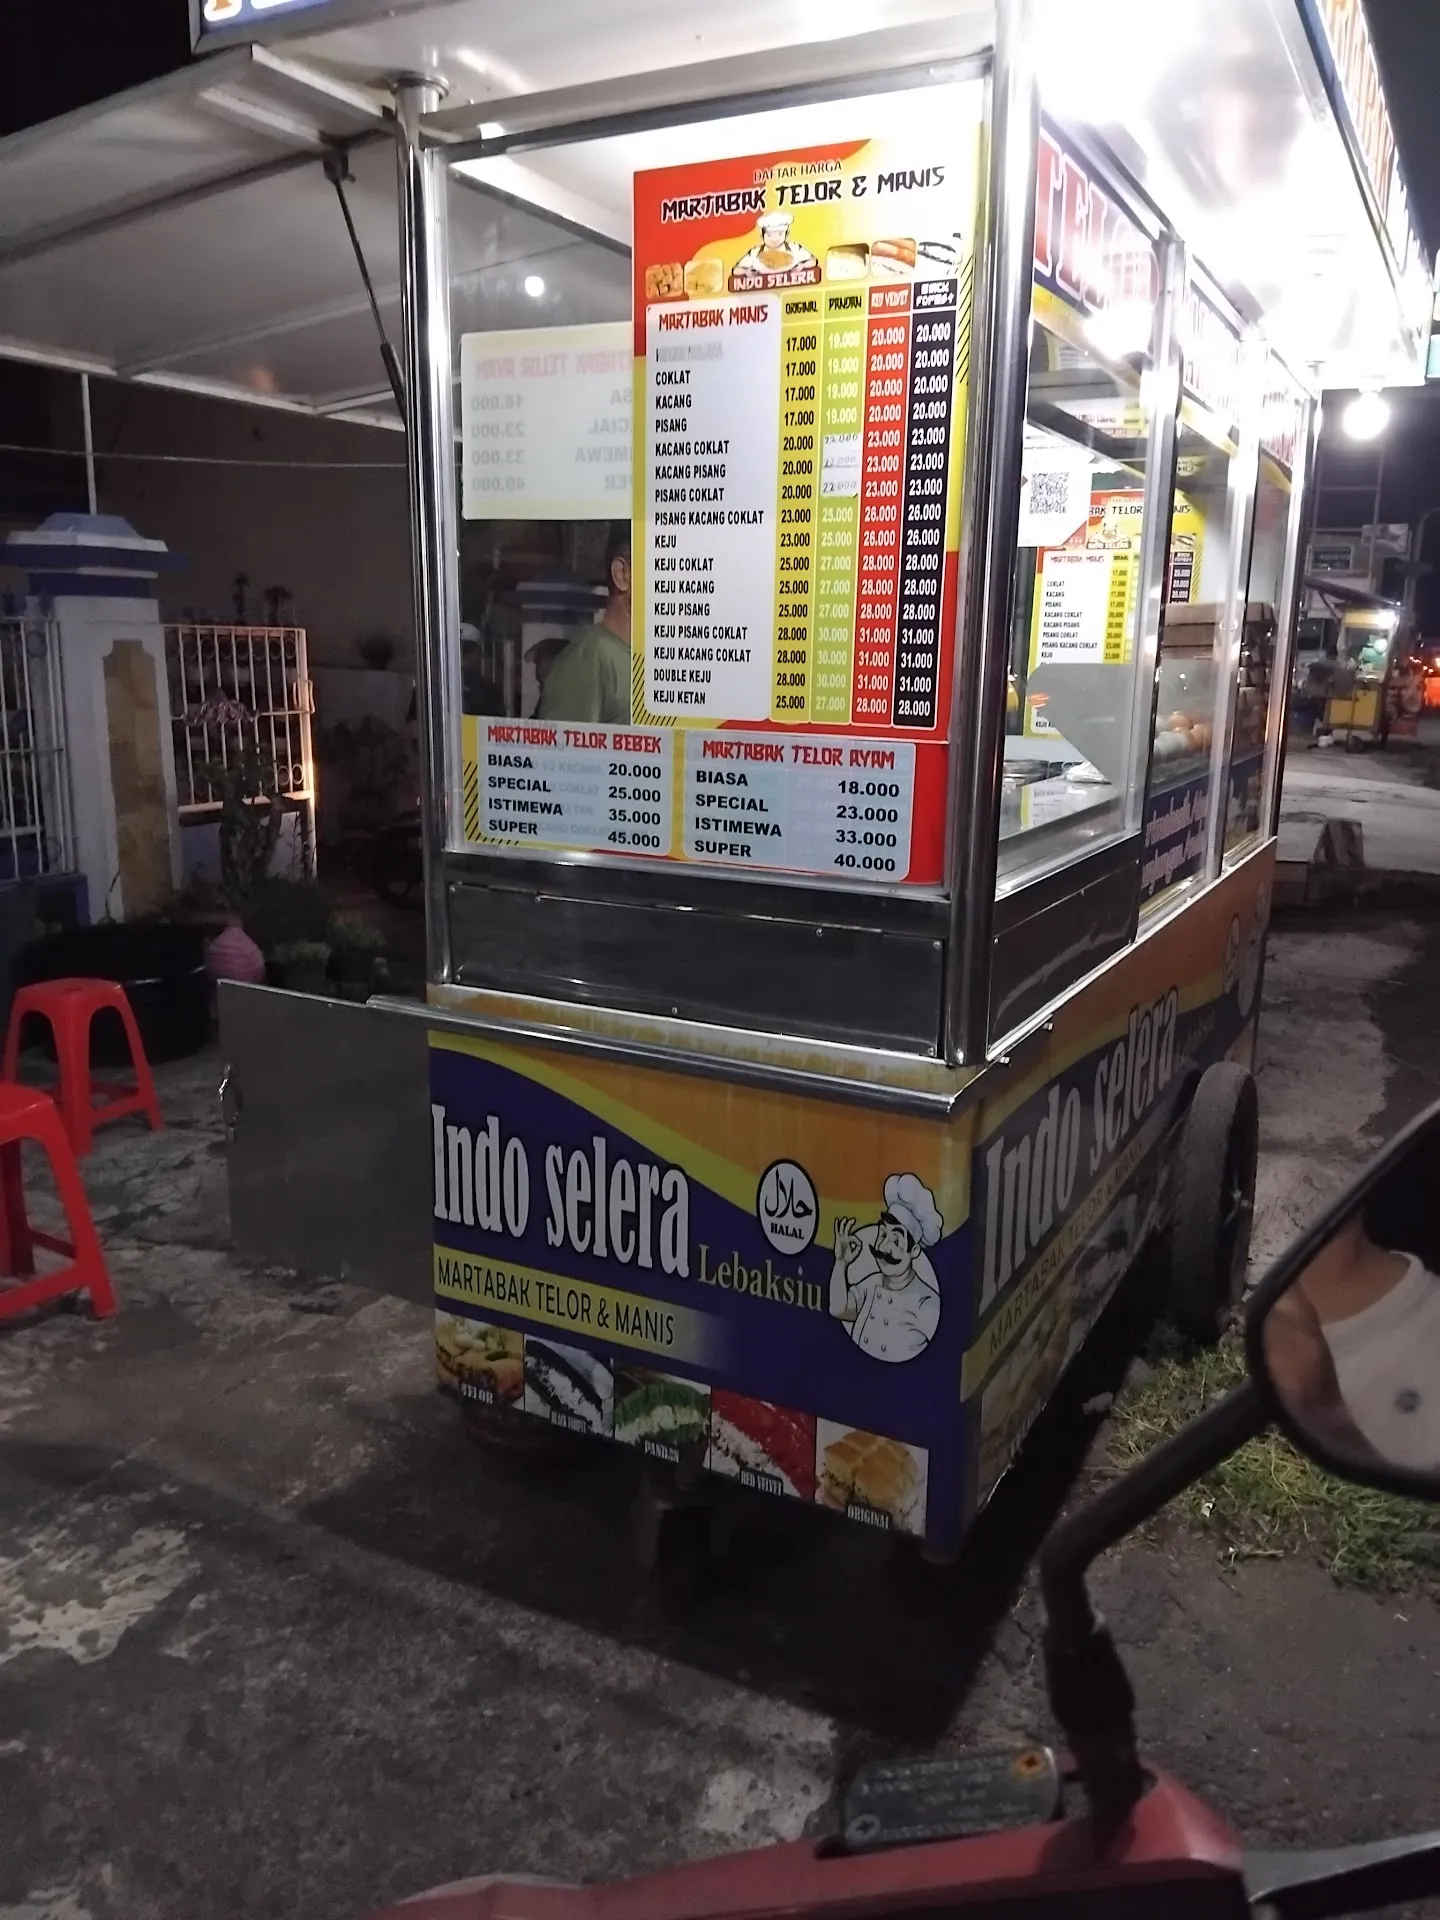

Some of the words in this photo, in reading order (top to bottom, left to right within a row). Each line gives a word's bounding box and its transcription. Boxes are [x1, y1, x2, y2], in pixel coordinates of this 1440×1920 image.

[754, 166, 798, 182] DAFTAR
[800, 159, 842, 176] HARGA
[662, 189, 766, 222] MARTABAK
[776, 179, 842, 206] TELOR
[852, 176, 868, 197] &
[878, 166, 945, 195] MANIS
[733, 276, 763, 291] INDO
[767, 271, 816, 288] SELERA
[658, 308, 723, 330] MARTABAK
[730, 305, 768, 325] MANIS
[785, 300, 817, 314] ORIGINAL
[786, 336, 816, 351] 17.000
[872, 327, 904, 345] 20.000
[916, 323, 950, 342] 20.000
[656, 370, 691, 385] COKLAT
[786, 362, 816, 376] 17.000
[870, 353, 903, 371] 20.000
[915, 349, 949, 368] 20.000
[656, 395, 692, 409] KACANG
[785, 387, 814, 401] 17.000
[870, 379, 902, 396] 20.000
[914, 375, 947, 393] 20.000
[656, 419, 687, 432] PISANG
[784, 412, 814, 426] 17.000
[869, 405, 901, 422] 20.000
[913, 401, 946, 419] 20.000
[656, 443, 691, 456] KACANG
[694, 440, 729, 455] COKLAT
[784, 436, 813, 450] 20.000
[868, 430, 900, 447] 23.000
[912, 428, 945, 445] 23.000
[656, 466, 691, 479] KACANG
[693, 464, 725, 478] PISANG
[783, 461, 812, 475] 20.000
[867, 455, 899, 472] 23.000
[911, 453, 943, 470] 23.000
[655, 489, 686, 502] PISANG
[689, 488, 724, 501] COKLAT
[782, 485, 811, 499] 20.000
[866, 480, 898, 496] 23.000
[910, 478, 942, 495] 23.000
[655, 512, 686, 525] PISANG
[688, 512, 725, 524] KACANG
[728, 511, 763, 523] COKLAT
[781, 510, 810, 523] 23.000
[822, 508, 852, 523] 25.000
[864, 505, 896, 522] 26.000
[908, 503, 941, 521] 26.000
[655, 536, 676, 548] KEJU
[781, 533, 809, 547] 23.000
[822, 531, 852, 546] 25.000
[864, 530, 895, 546] 26.000
[907, 528, 939, 545] 26.000
[654, 559, 676, 571] KEJU
[679, 558, 713, 570] COKLAT
[780, 557, 809, 571] 25.000
[820, 556, 851, 570] 27.000
[863, 554, 894, 571] 28.000
[906, 553, 938, 570] 28.000
[654, 581, 676, 593] KEJU
[679, 581, 714, 594] KACANG
[779, 581, 808, 594] 25.000
[820, 580, 850, 594] 27.000
[862, 579, 893, 595] 28.000
[904, 578, 936, 595] 28.000
[654, 603, 676, 615] KEJU
[679, 604, 710, 616] PISANG
[779, 604, 808, 618] 25.000
[819, 604, 849, 618] 27.000
[861, 603, 892, 619] 28.000
[903, 603, 935, 620] 28.000
[654, 626, 676, 638] KEJU
[679, 626, 709, 639] PISANG
[712, 627, 747, 639] COKLAT
[778, 628, 806, 641] 28.000
[818, 628, 848, 642] 30.000
[860, 627, 890, 643] 31.000
[902, 628, 933, 644] 31.000
[654, 647, 675, 659] KEJU
[678, 648, 714, 661] KACANG
[716, 650, 750, 662] COKLAT
[778, 651, 806, 664] 28.000
[817, 651, 847, 665] 30.000
[859, 651, 889, 667] 31.000
[901, 652, 932, 668] 31.000
[654, 669, 686, 682] DOUBLE
[689, 671, 711, 683] KEJU
[777, 674, 805, 687] 28.000
[817, 674, 846, 688] 30.000
[858, 675, 888, 690] 31.000
[900, 676, 931, 692] 31.000
[653, 691, 675, 703] KEJU
[677, 692, 705, 704] KETAN
[776, 696, 805, 709] 25.000
[816, 697, 845, 711] 27.000
[857, 698, 887, 714] 28.000
[898, 700, 930, 716] 28.000
[487, 725, 558, 746] MARTABAK
[564, 731, 607, 751] TELOR
[613, 734, 661, 754] BEBEK
[488, 754, 533, 769] BIASA
[609, 763, 661, 779] 20.000
[702, 740, 784, 764] MARTABAK
[792, 745, 843, 767] TELOR
[849, 748, 894, 769] AYAM
[488, 776, 550, 793] SPECIAL
[608, 786, 661, 802] 25.000
[696, 770, 749, 787] BIASA
[838, 781, 899, 797] 18.000
[488, 797, 563, 816] ISTIMEWA
[608, 809, 661, 825] 35.000
[695, 794, 768, 813] SPECIAL
[836, 806, 898, 823] 23.000
[488, 819, 538, 836] SUPER
[608, 832, 660, 848] 45.000
[695, 817, 782, 836] ISTIMEWA
[836, 830, 897, 847] 33.000
[695, 840, 751, 858] SUPER
[834, 854, 895, 872] 40.000
[432, 1105, 529, 1238] Indo
[546, 1137, 689, 1278] selera
[979, 1083, 1081, 1317] Indo
[770, 1223, 804, 1239] HALAL
[698, 1243, 822, 1312] Lebaksiu
[437, 1257, 530, 1310] MARTABAK
[535, 1283, 591, 1325] TELOR
[597, 1297, 610, 1328] &
[615, 1305, 674, 1347] MANIS
[989, 1243, 1065, 1355] MARTABAK
[741, 1470, 756, 1486] RED
[757, 1473, 782, 1495] VELVET
